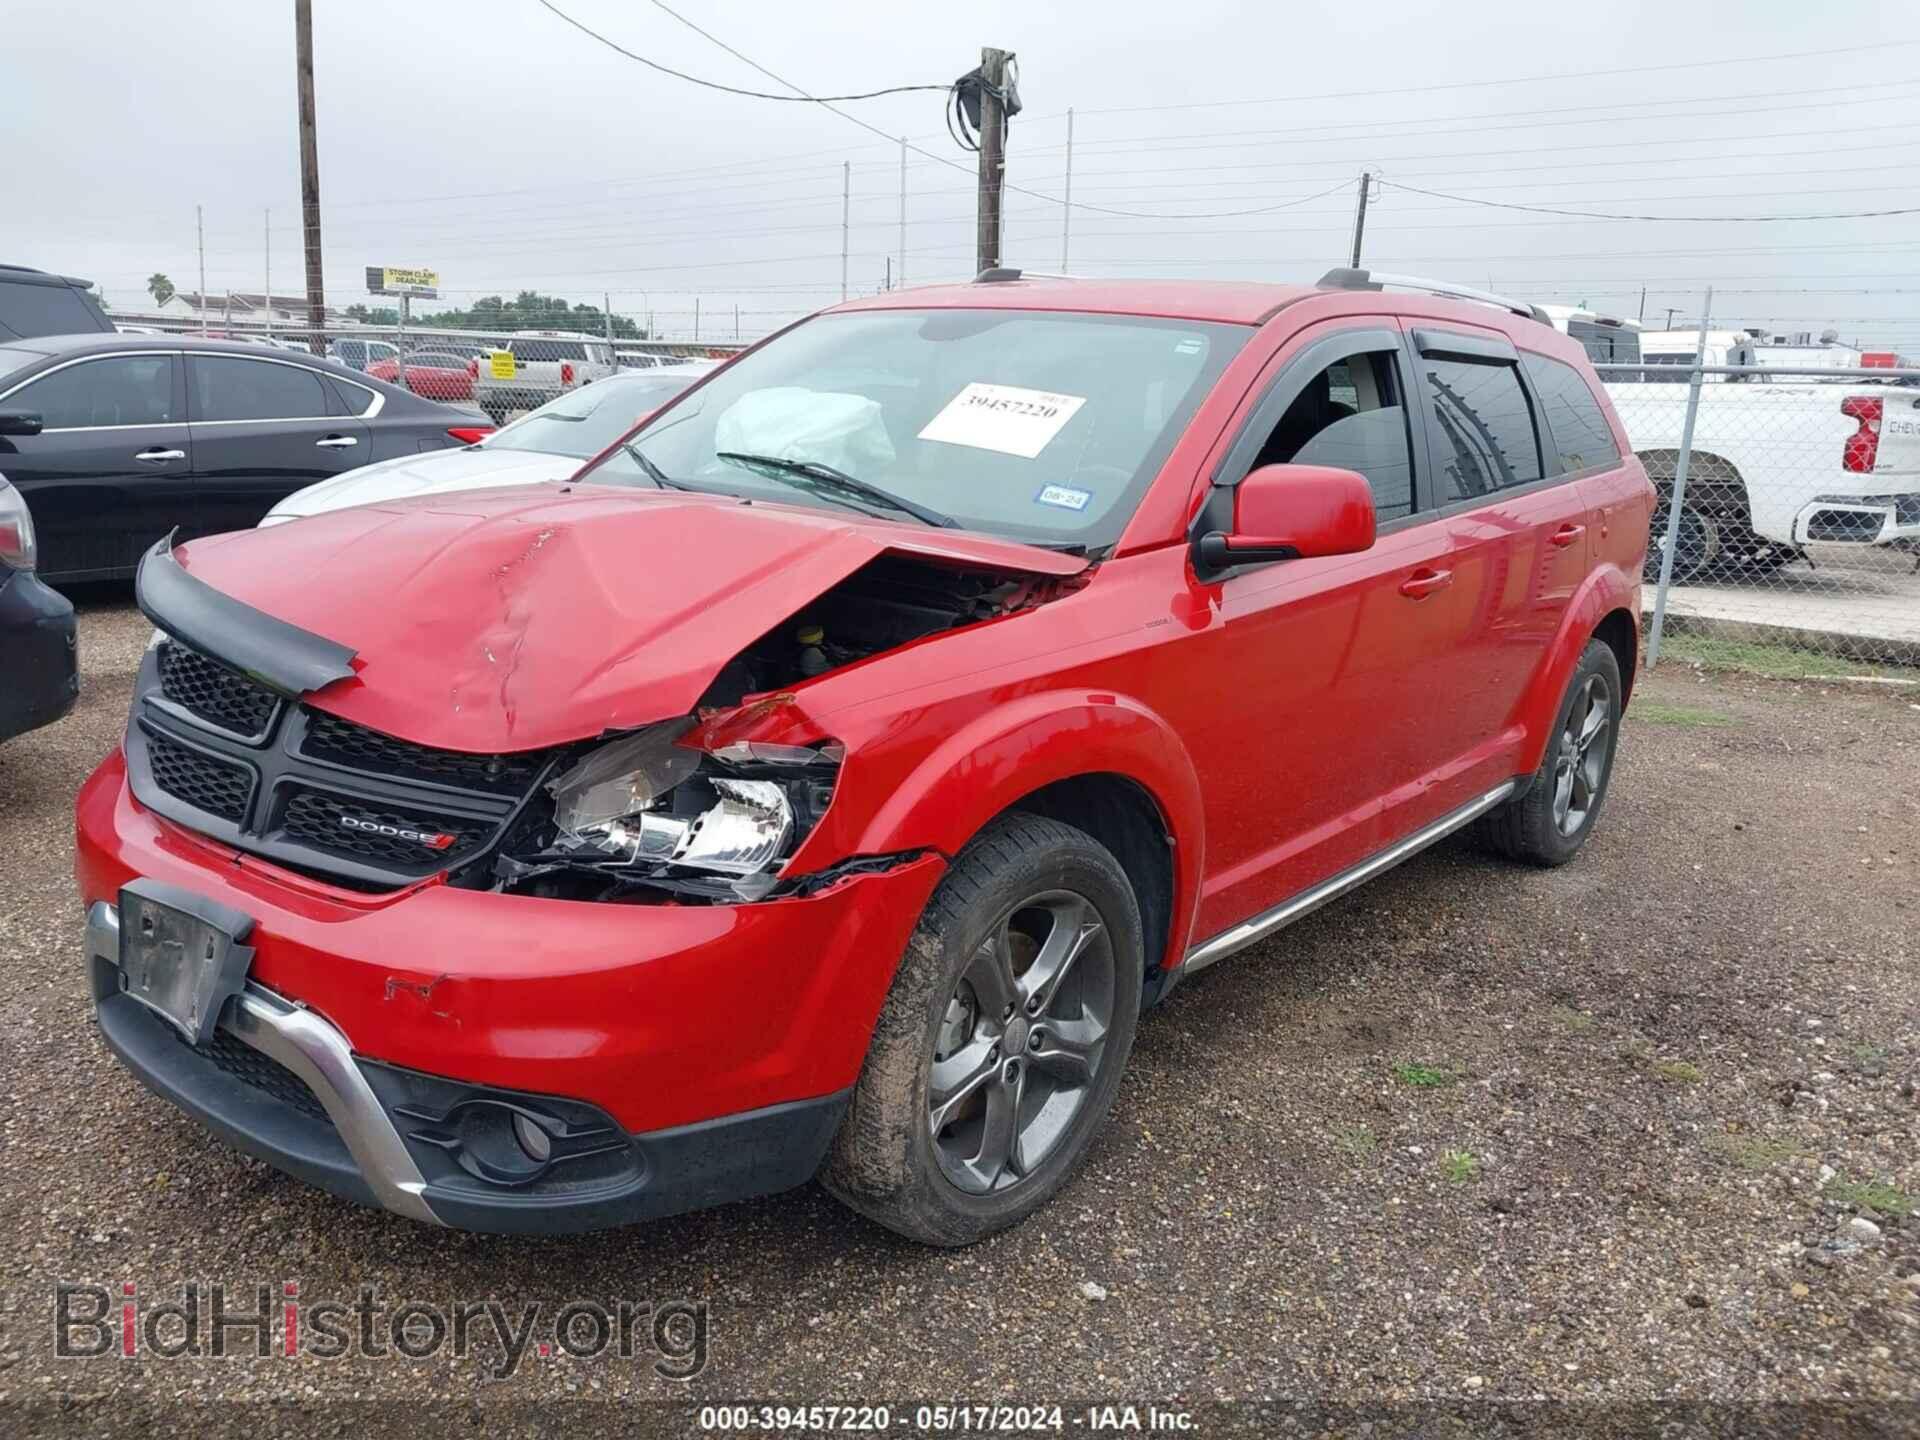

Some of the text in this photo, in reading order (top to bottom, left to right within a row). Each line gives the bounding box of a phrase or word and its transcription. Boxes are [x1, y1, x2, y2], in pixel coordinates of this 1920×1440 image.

[388, 268, 435, 279] STORM CLAIM
[395, 276, 430, 285] DEADLINE
[961, 395, 1057, 418] 39457220
[341, 816, 438, 845] DODGE
